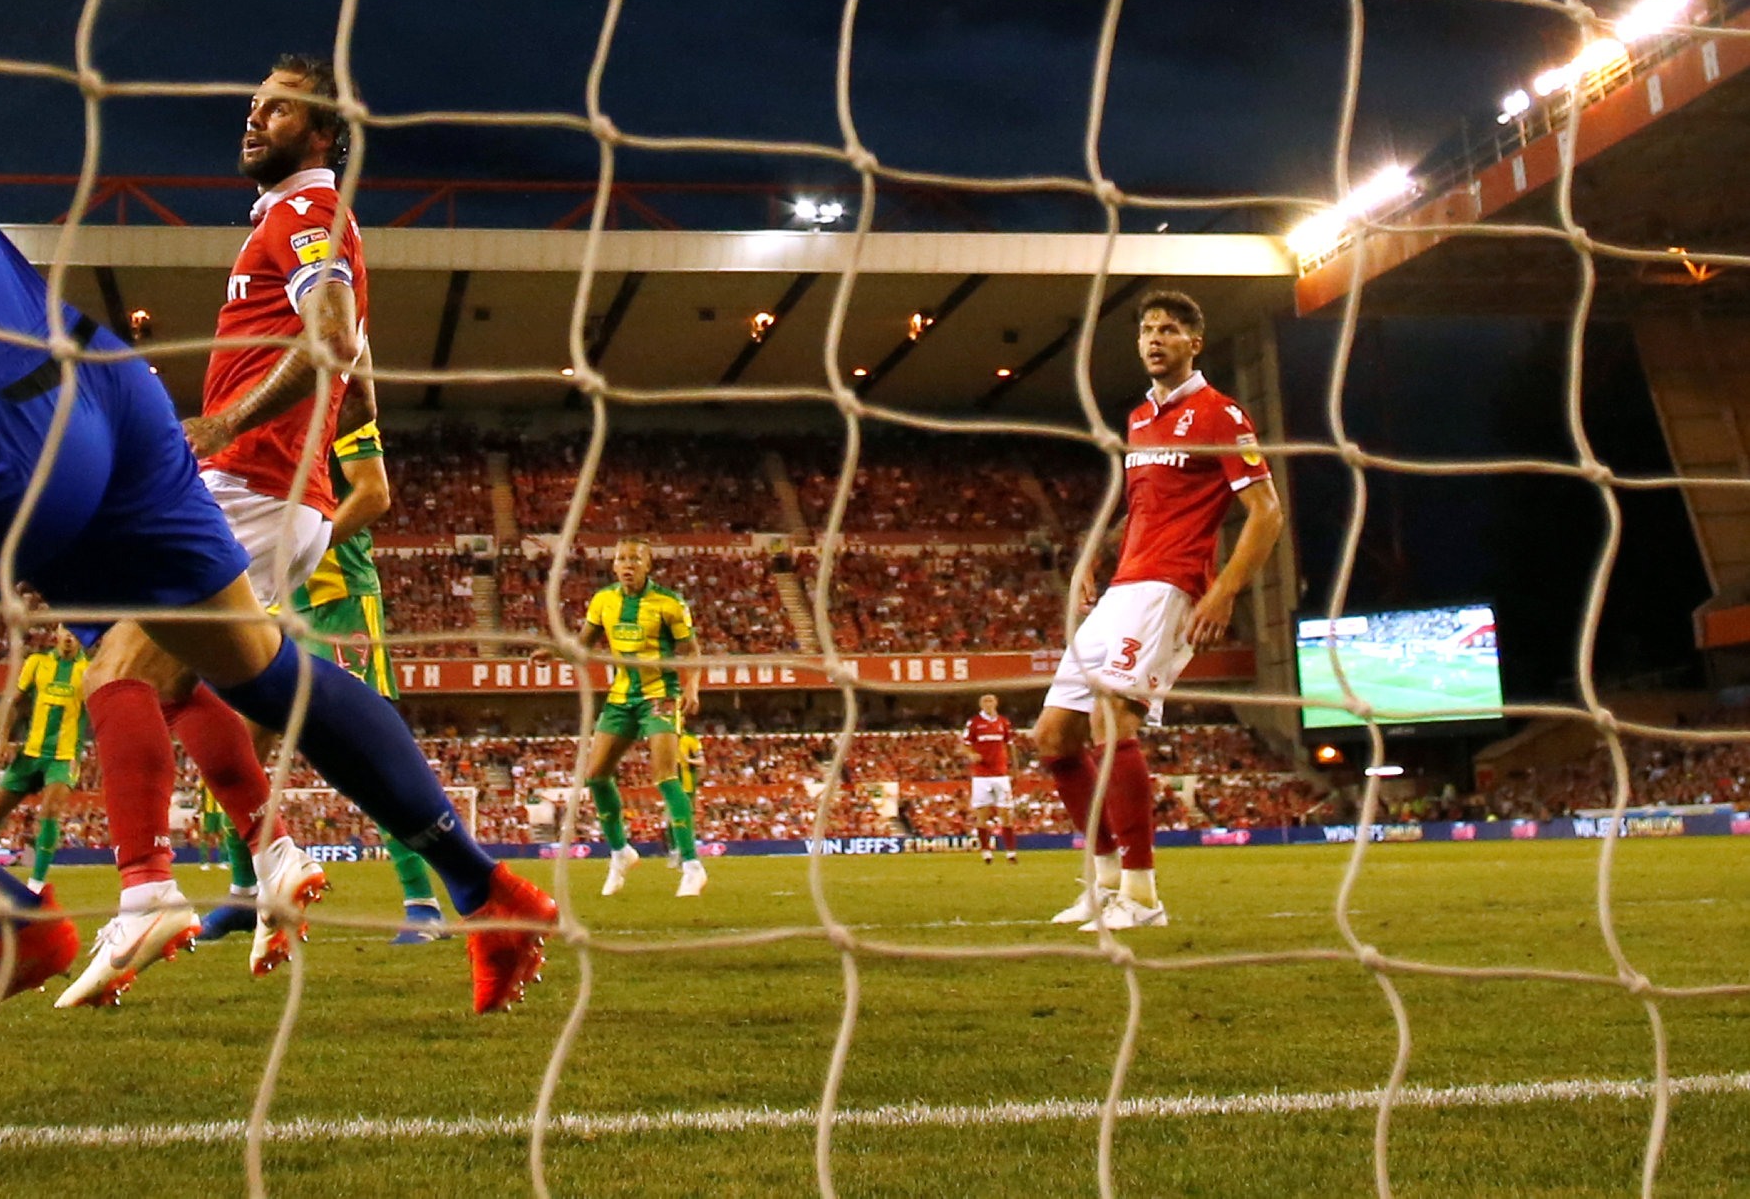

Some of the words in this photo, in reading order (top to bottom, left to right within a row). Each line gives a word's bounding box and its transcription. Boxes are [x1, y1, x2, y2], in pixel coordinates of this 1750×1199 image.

[1111, 637, 1142, 670] 3
[472, 663, 574, 687] PRIDE
[889, 658, 970, 682] 1865
[804, 838, 843, 855] WIN
[844, 837, 900, 855] JEFF'S
